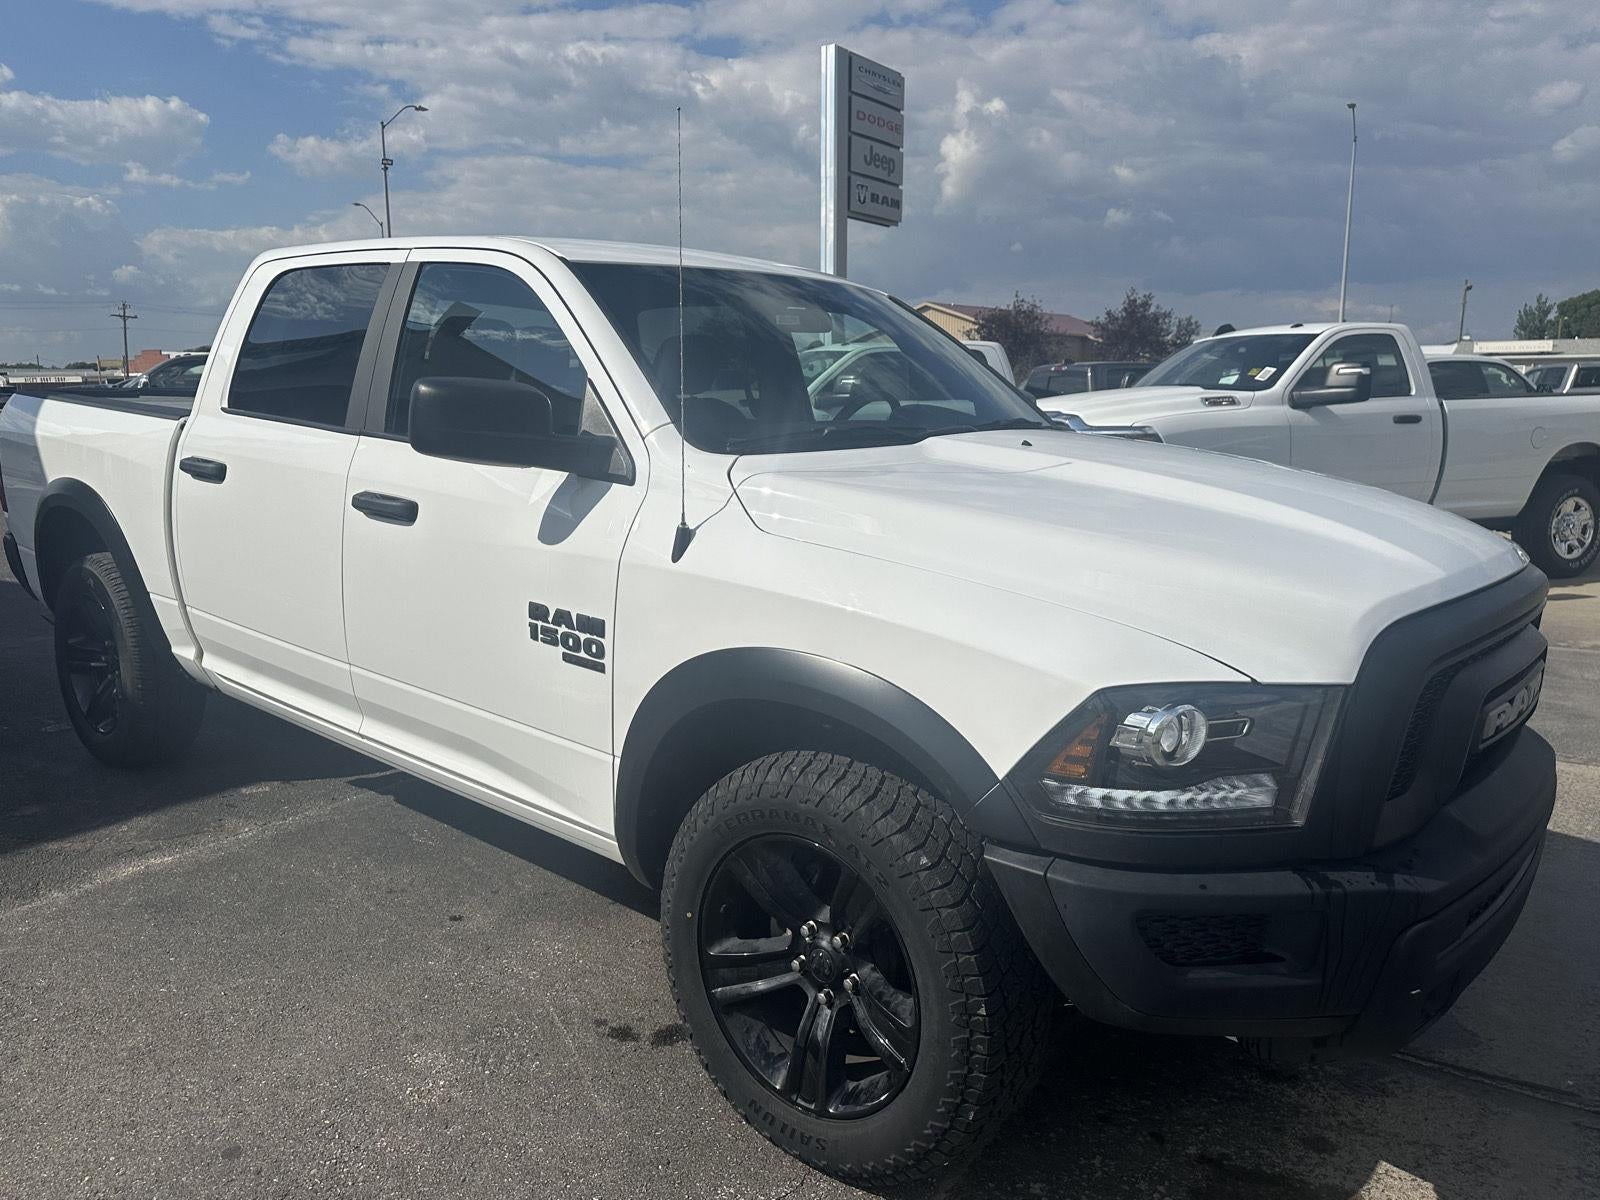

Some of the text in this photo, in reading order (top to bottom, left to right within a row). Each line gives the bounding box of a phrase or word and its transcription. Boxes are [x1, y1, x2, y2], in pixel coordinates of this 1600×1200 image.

[858, 65, 902, 88] CHRYSLER
[856, 110, 901, 134] DODGE
[864, 145, 896, 177] Jeep
[870, 192, 900, 210] RAM
[528, 600, 606, 640] RAM
[528, 621, 606, 661] 1500
[1481, 672, 1542, 740] RAM
[747, 1098, 828, 1151] SAILUN
